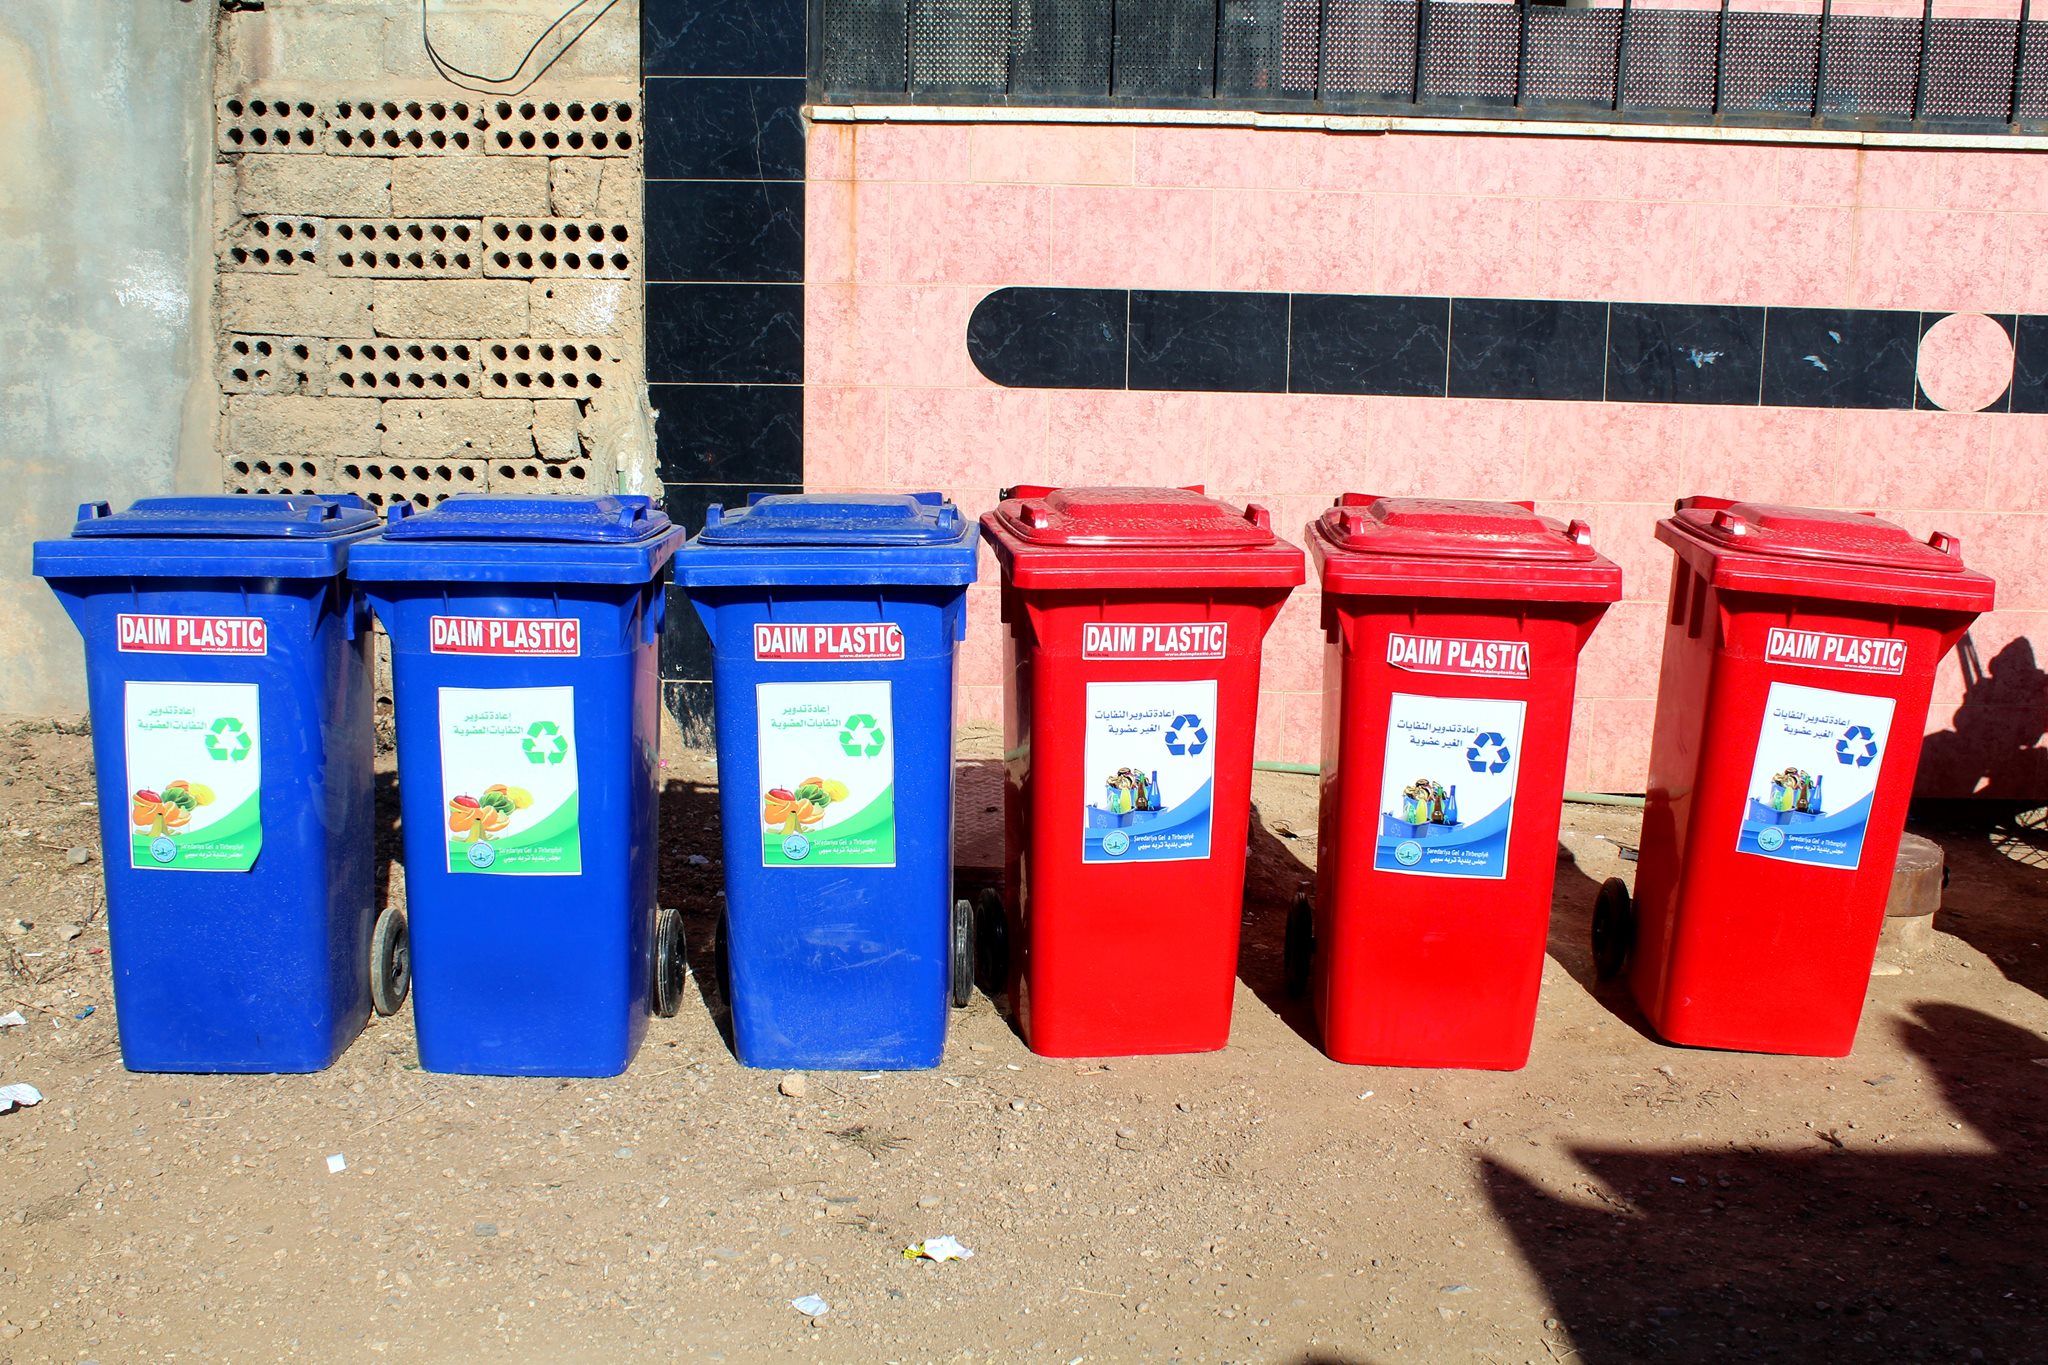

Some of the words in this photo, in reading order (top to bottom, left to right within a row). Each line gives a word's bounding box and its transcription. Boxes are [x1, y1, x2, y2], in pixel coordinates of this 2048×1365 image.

[122, 618, 170, 644] DAIM
[177, 619, 262, 647] PLASTIC
[434, 619, 482, 646] DAIM
[490, 621, 575, 648] PLASTIC
[759, 627, 808, 653] DAIM
[815, 626, 900, 653] PLASTIC
[1087, 626, 1136, 652] DAIM
[1142, 626, 1222, 652] PLASTIC
[1391, 637, 1442, 665] DAIM
[1770, 631, 1820, 660] DAIM
[1823, 637, 1903, 667] PLASTIC
[1844, 664, 1899, 672] www.daimplastic.com
[148, 706, 172, 716] تدوير
[782, 704, 807, 715] تدوير
[1129, 710, 1152, 720] تدوير
[1154, 710, 1175, 720] إعادة
[1773, 709, 1805, 720] النفايات
[464, 712, 488, 722] تدوير
[1095, 710, 1128, 721] النفايات
[1805, 716, 1829, 724] تدوير
[138, 720, 172, 731] العضوية
[173, 720, 207, 732] النفايات
[771, 718, 806, 729] العضوية
[807, 718, 841, 729] النفايات
[1397, 720, 1431, 731] النفايات
[1829, 716, 1850, 728] إعادة
[453, 725, 488, 736] العضوية
[489, 725, 523, 736] النفايات
[1108, 724, 1138, 735] عضوية
[1140, 724, 1160, 734] الغير
[1431, 725, 1456, 734] تدوير
[1457, 725, 1479, 735] إعادة
[1784, 724, 1812, 735] عضوية
[1813, 730, 1833, 739] الغير
[1410, 735, 1440, 747] عضوية
[1442, 739, 1462, 748] الغير
[1817, 846, 1830, 854] بلدية
[1458, 857, 1471, 865] بلدية
